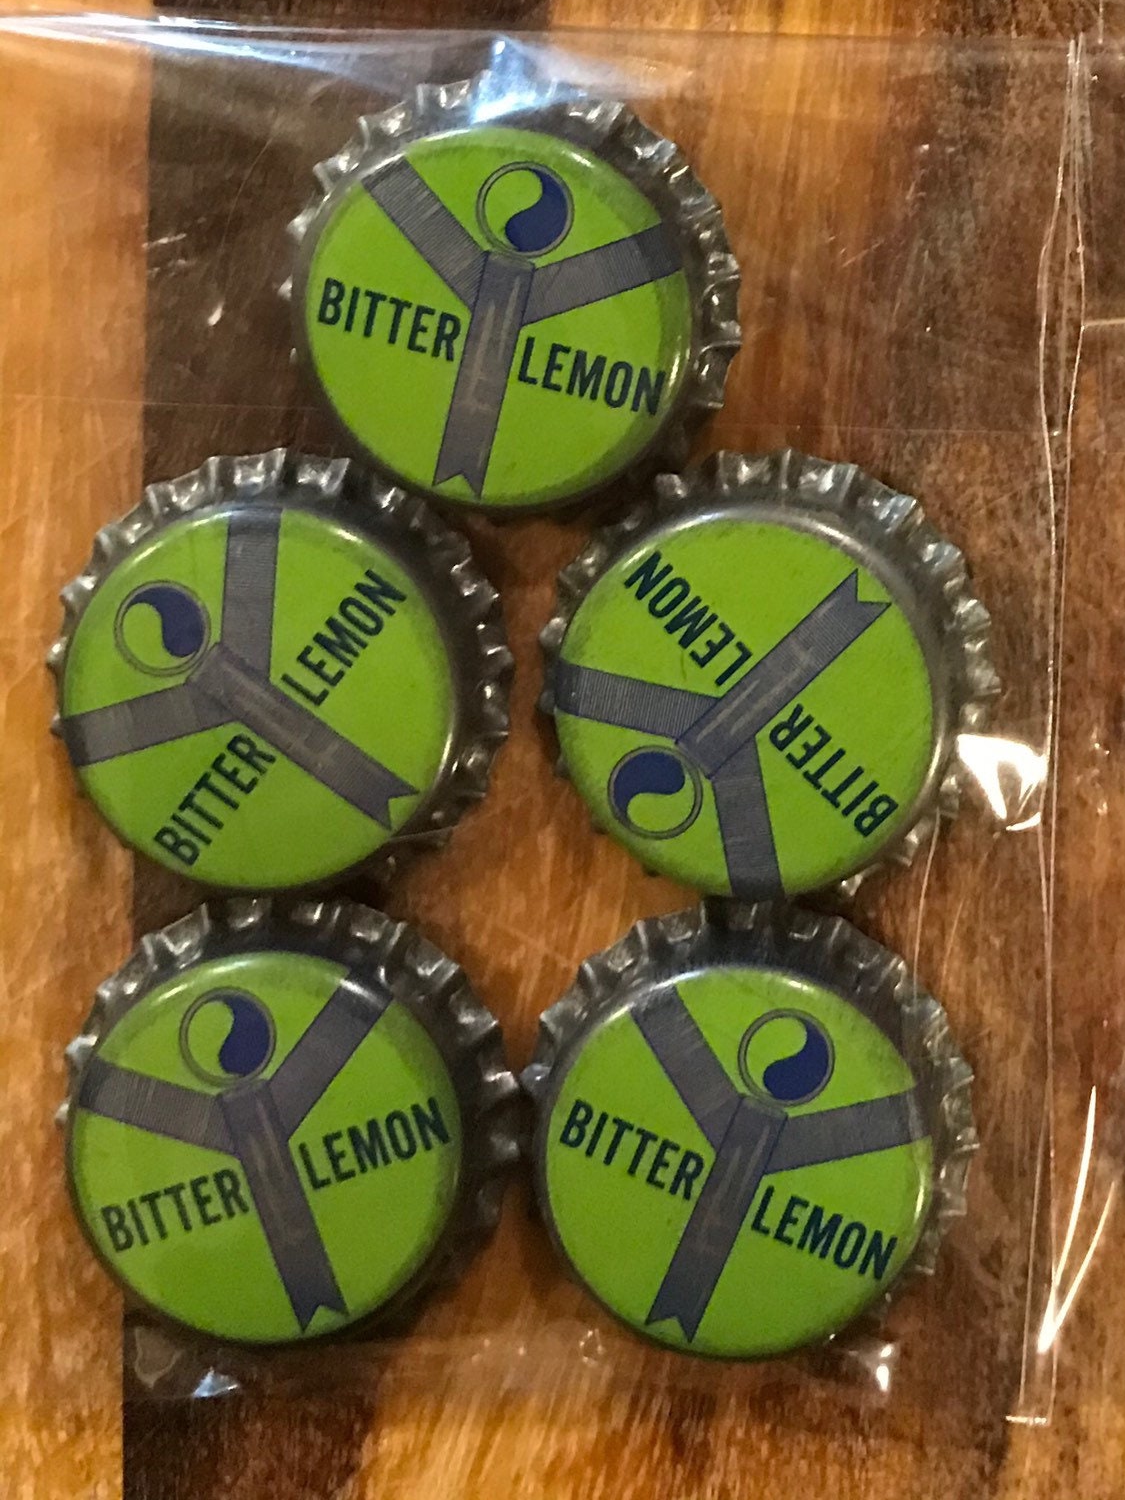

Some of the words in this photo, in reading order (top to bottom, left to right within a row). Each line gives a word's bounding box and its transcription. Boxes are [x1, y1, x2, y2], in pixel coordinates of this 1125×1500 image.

[317, 278, 462, 362] BITTER
[517, 336, 667, 417] LEMON
[623, 550, 754, 687] LEMON
[154, 733, 277, 867] BITTER
[280, 569, 407, 707] LEMON
[769, 703, 900, 838] BITTER
[101, 1168, 250, 1253] BITTER
[298, 1096, 452, 1192] LEMON
[559, 1100, 705, 1201] BITTER
[750, 1185, 897, 1281] LEMON
